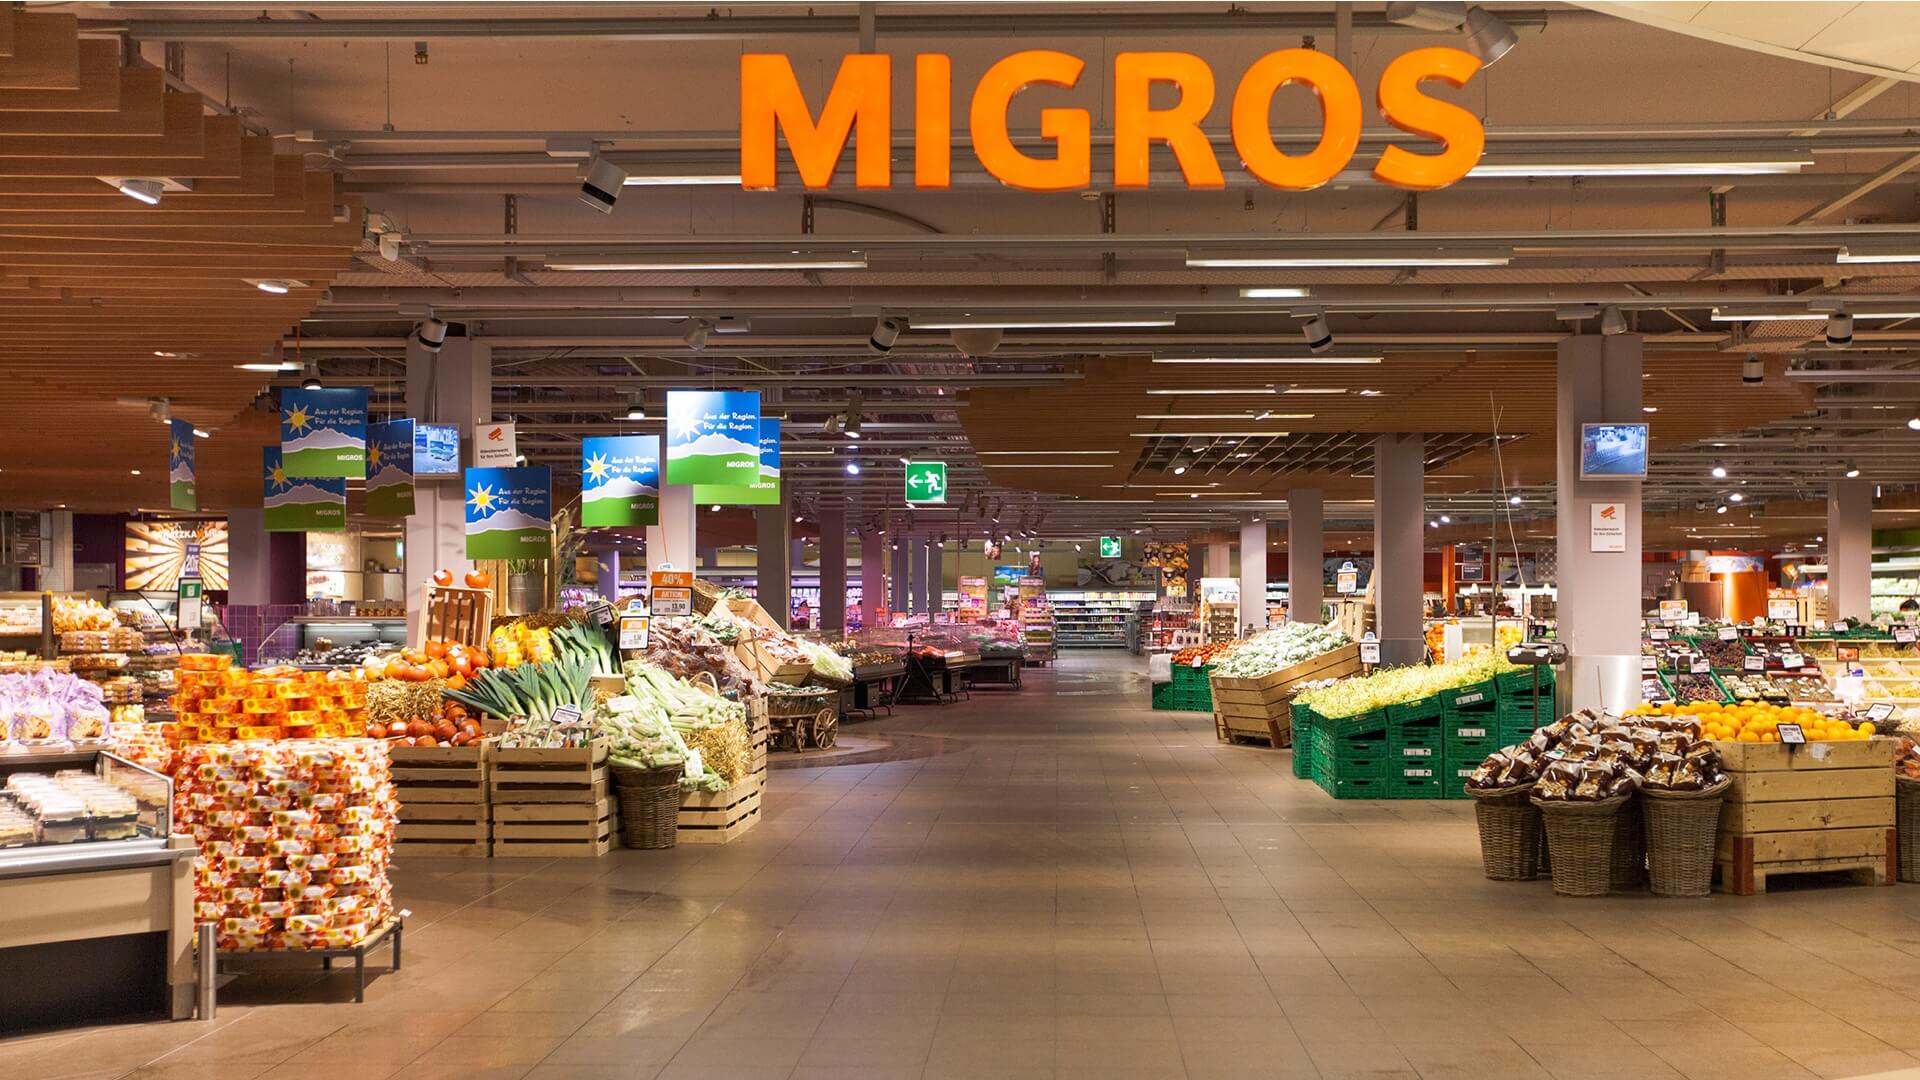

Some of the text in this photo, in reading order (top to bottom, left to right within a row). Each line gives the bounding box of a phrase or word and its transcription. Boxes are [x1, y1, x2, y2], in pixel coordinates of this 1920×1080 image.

[741, 47, 1486, 191] MIGROS
[703, 412, 717, 420] Aus
[732, 412, 757, 421] Region.
[703, 422, 715, 430] Für
[729, 422, 754, 431] Region.
[611, 456, 623, 464] Aus
[513, 487, 523, 495] der
[498, 497, 509, 505] Für
[662, 574, 684, 585] 40%
